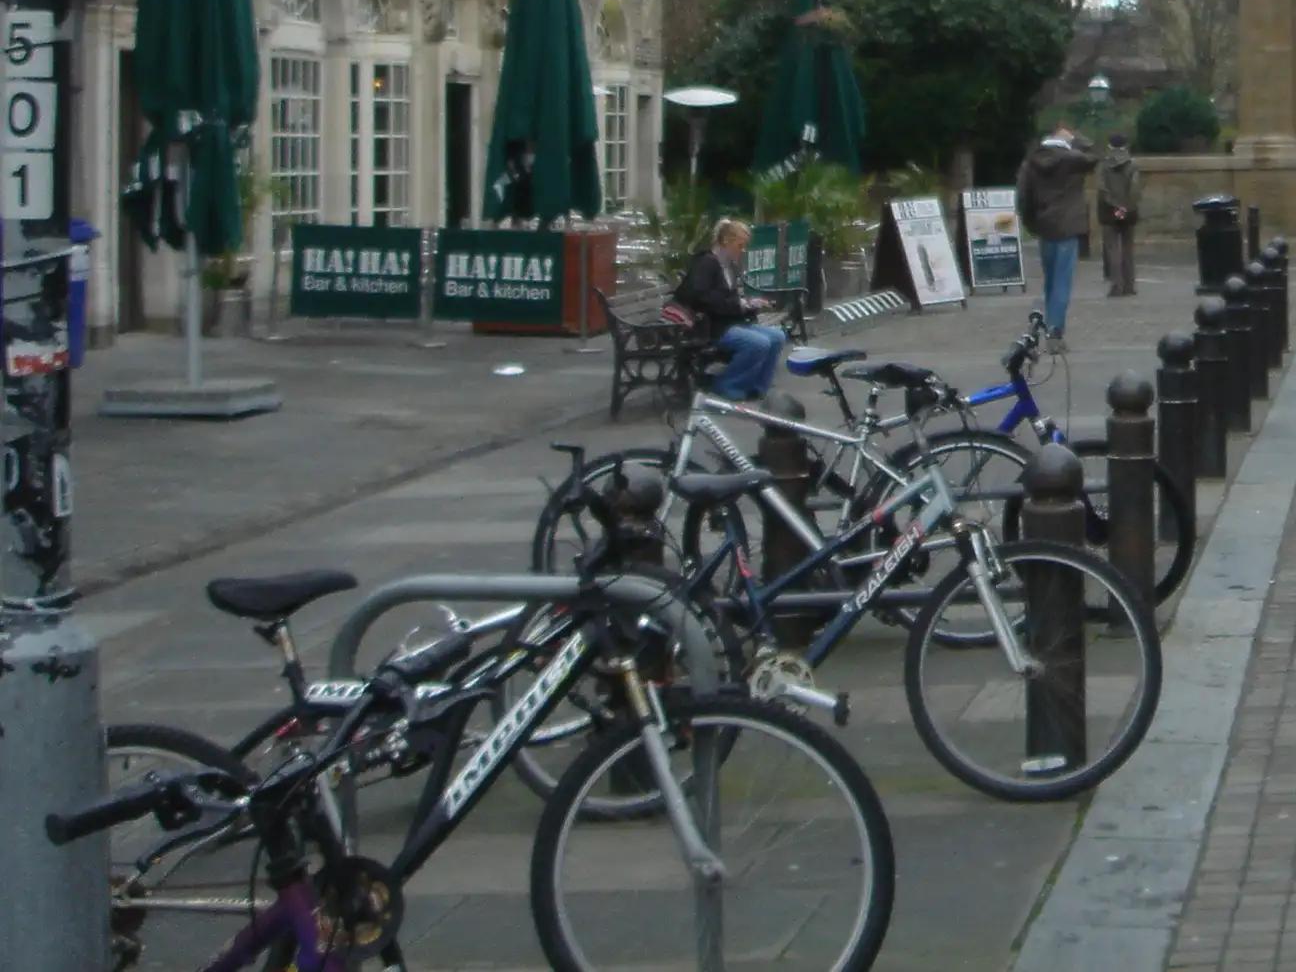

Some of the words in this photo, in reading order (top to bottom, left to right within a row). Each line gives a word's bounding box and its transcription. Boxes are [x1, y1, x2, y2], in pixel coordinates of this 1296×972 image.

[303, 249, 354, 273] HA!
[359, 251, 410, 276] HA!
[446, 254, 497, 279] HA!
[501, 256, 552, 282] HA!
[303, 276, 330, 291] Bar
[335, 276, 347, 292] &
[351, 278, 408, 294] kitchen
[445, 280, 474, 296] Bar
[477, 282, 489, 298] &
[494, 283, 550, 300] kitchen
[855, 525, 921, 610] RALEIGH
